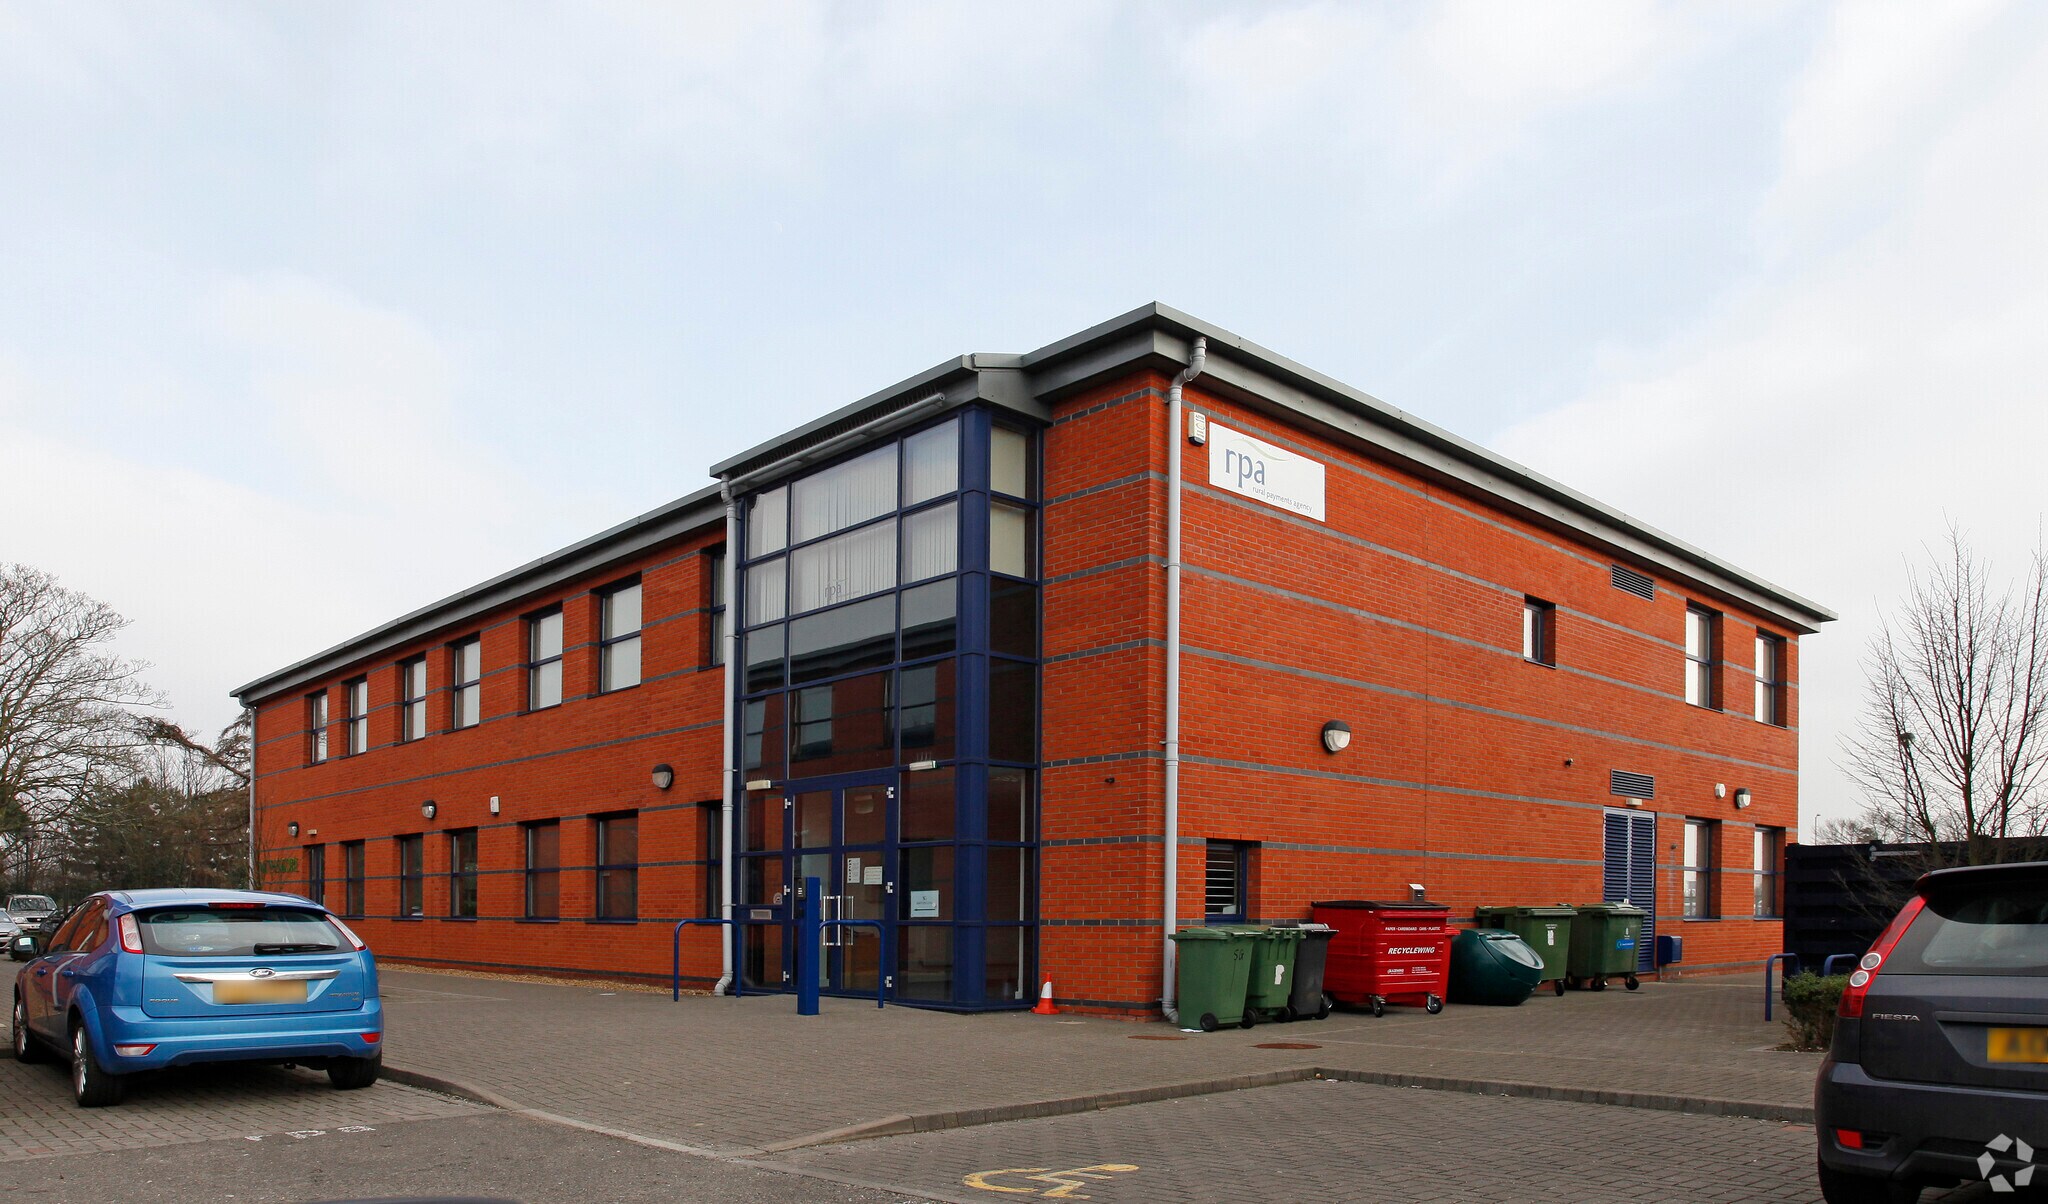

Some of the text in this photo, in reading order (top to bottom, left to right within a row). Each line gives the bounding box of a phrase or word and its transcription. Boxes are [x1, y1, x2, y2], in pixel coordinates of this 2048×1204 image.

[1225, 448, 1265, 488] rpa
[1252, 486, 1313, 514] rural payments agency
[1388, 947, 1435, 955] RECYCLEWING
[1872, 1013, 1920, 1022] FIESTA
